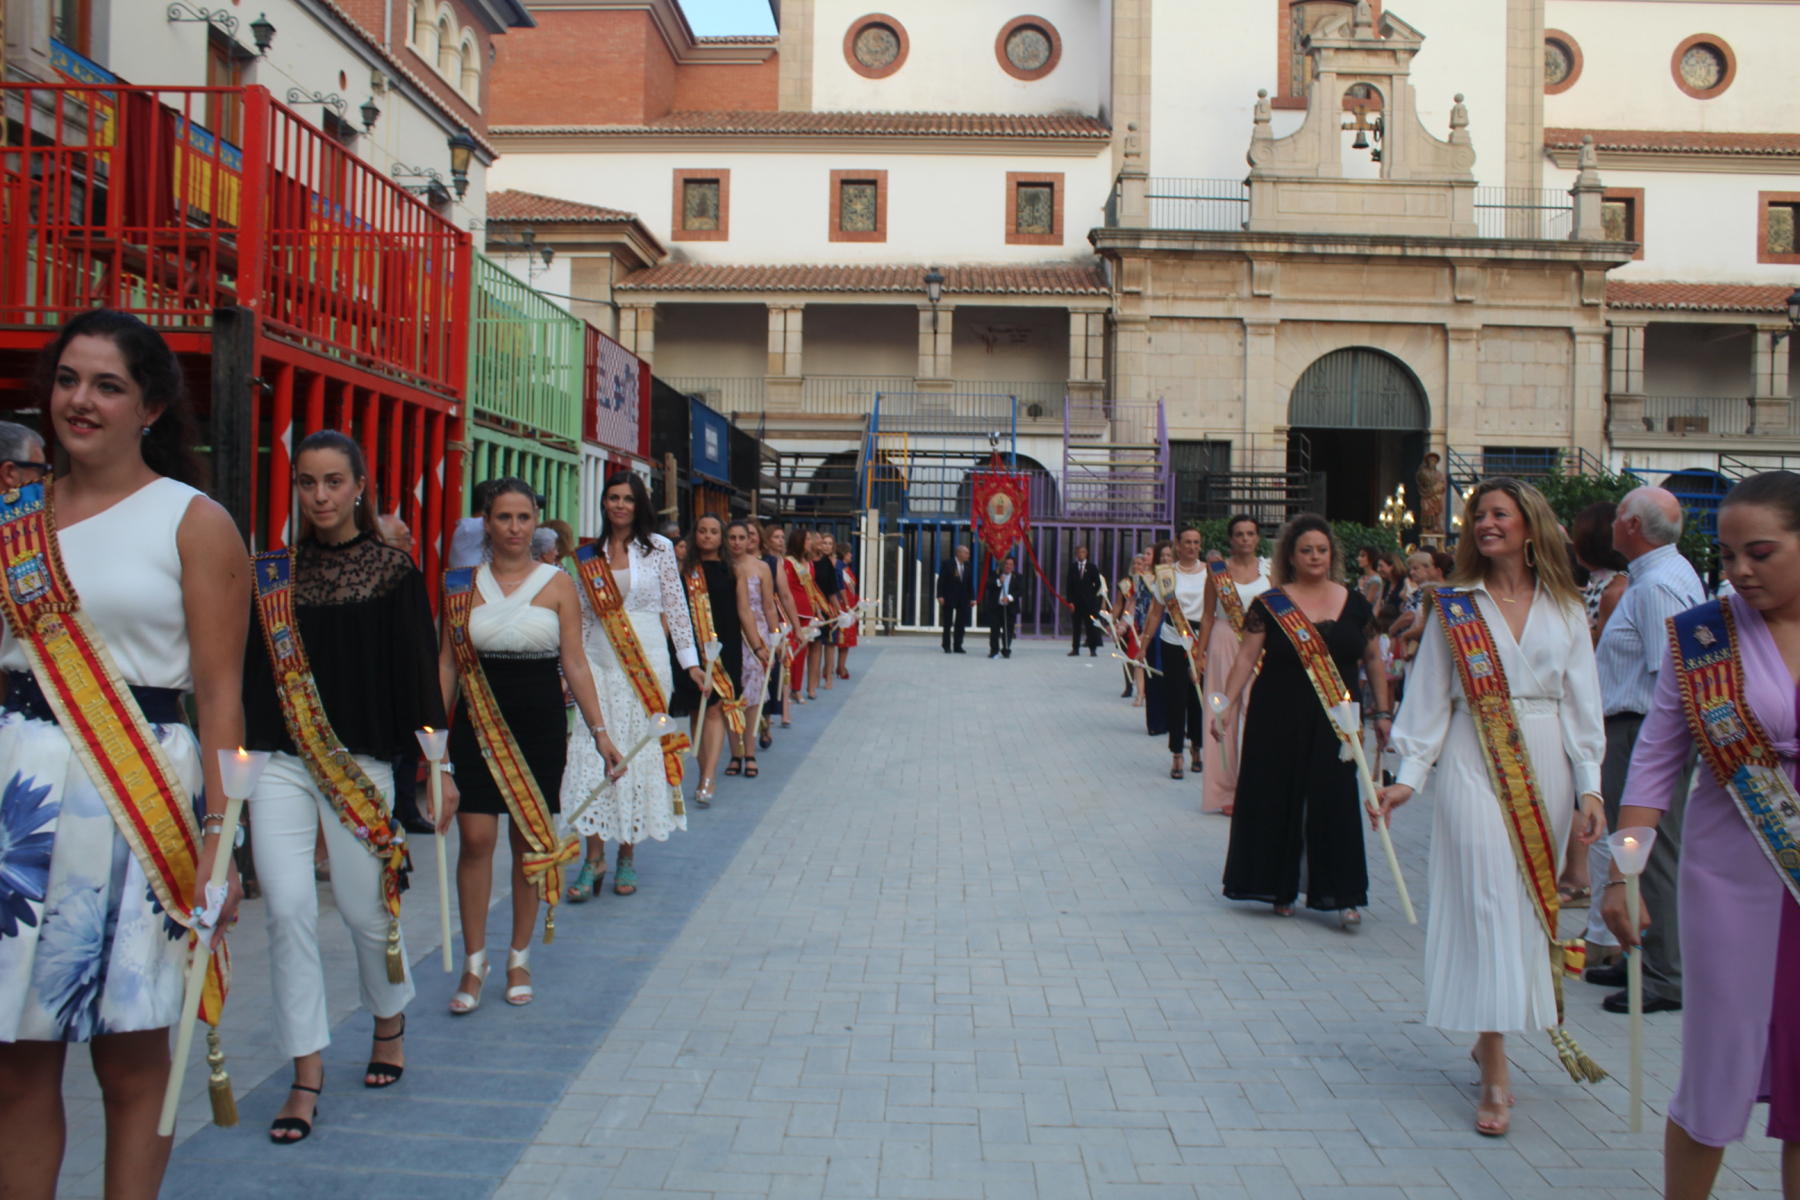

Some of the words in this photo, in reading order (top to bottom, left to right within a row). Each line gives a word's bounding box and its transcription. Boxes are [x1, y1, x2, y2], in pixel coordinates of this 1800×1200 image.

[51, 639, 88, 694] Reina
[80, 692, 137, 765] Infantil
[123, 766, 145, 790] de
[136, 791, 157, 814] la
